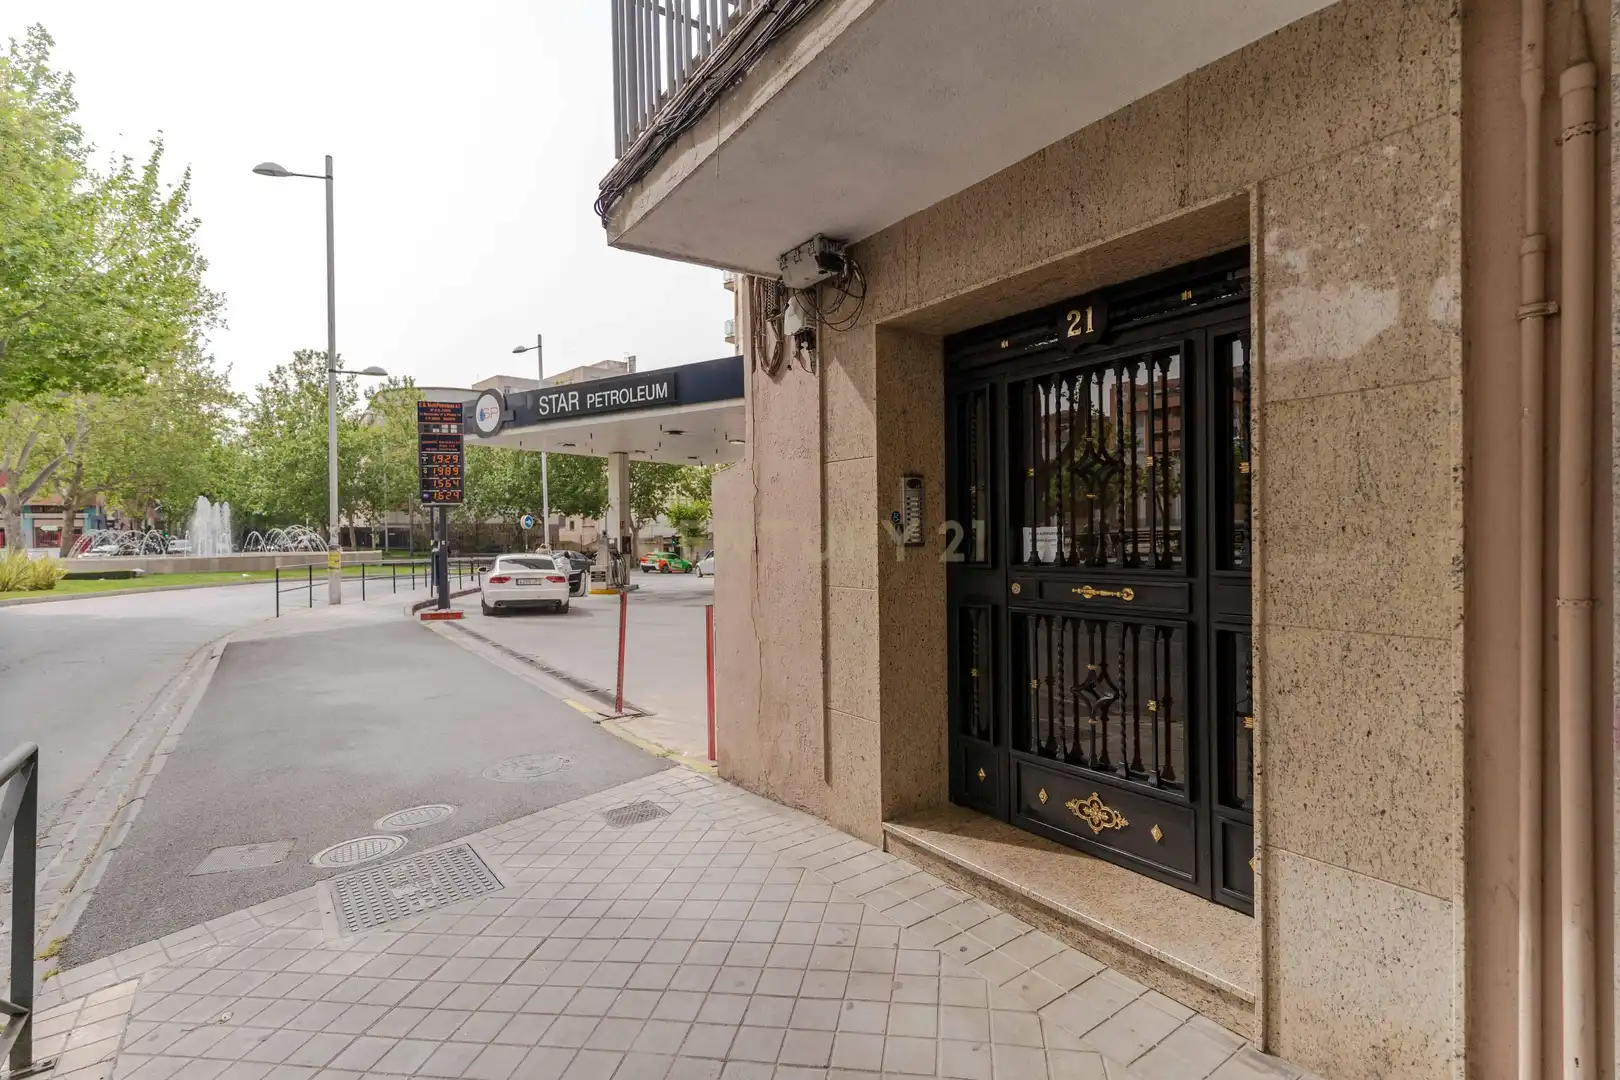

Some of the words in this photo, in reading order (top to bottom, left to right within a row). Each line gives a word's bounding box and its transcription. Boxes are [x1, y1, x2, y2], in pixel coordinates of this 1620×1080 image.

[1067, 306, 1094, 338] 21
[539, 391, 580, 416] STAR
[586, 382, 669, 410] PETROLEUM
